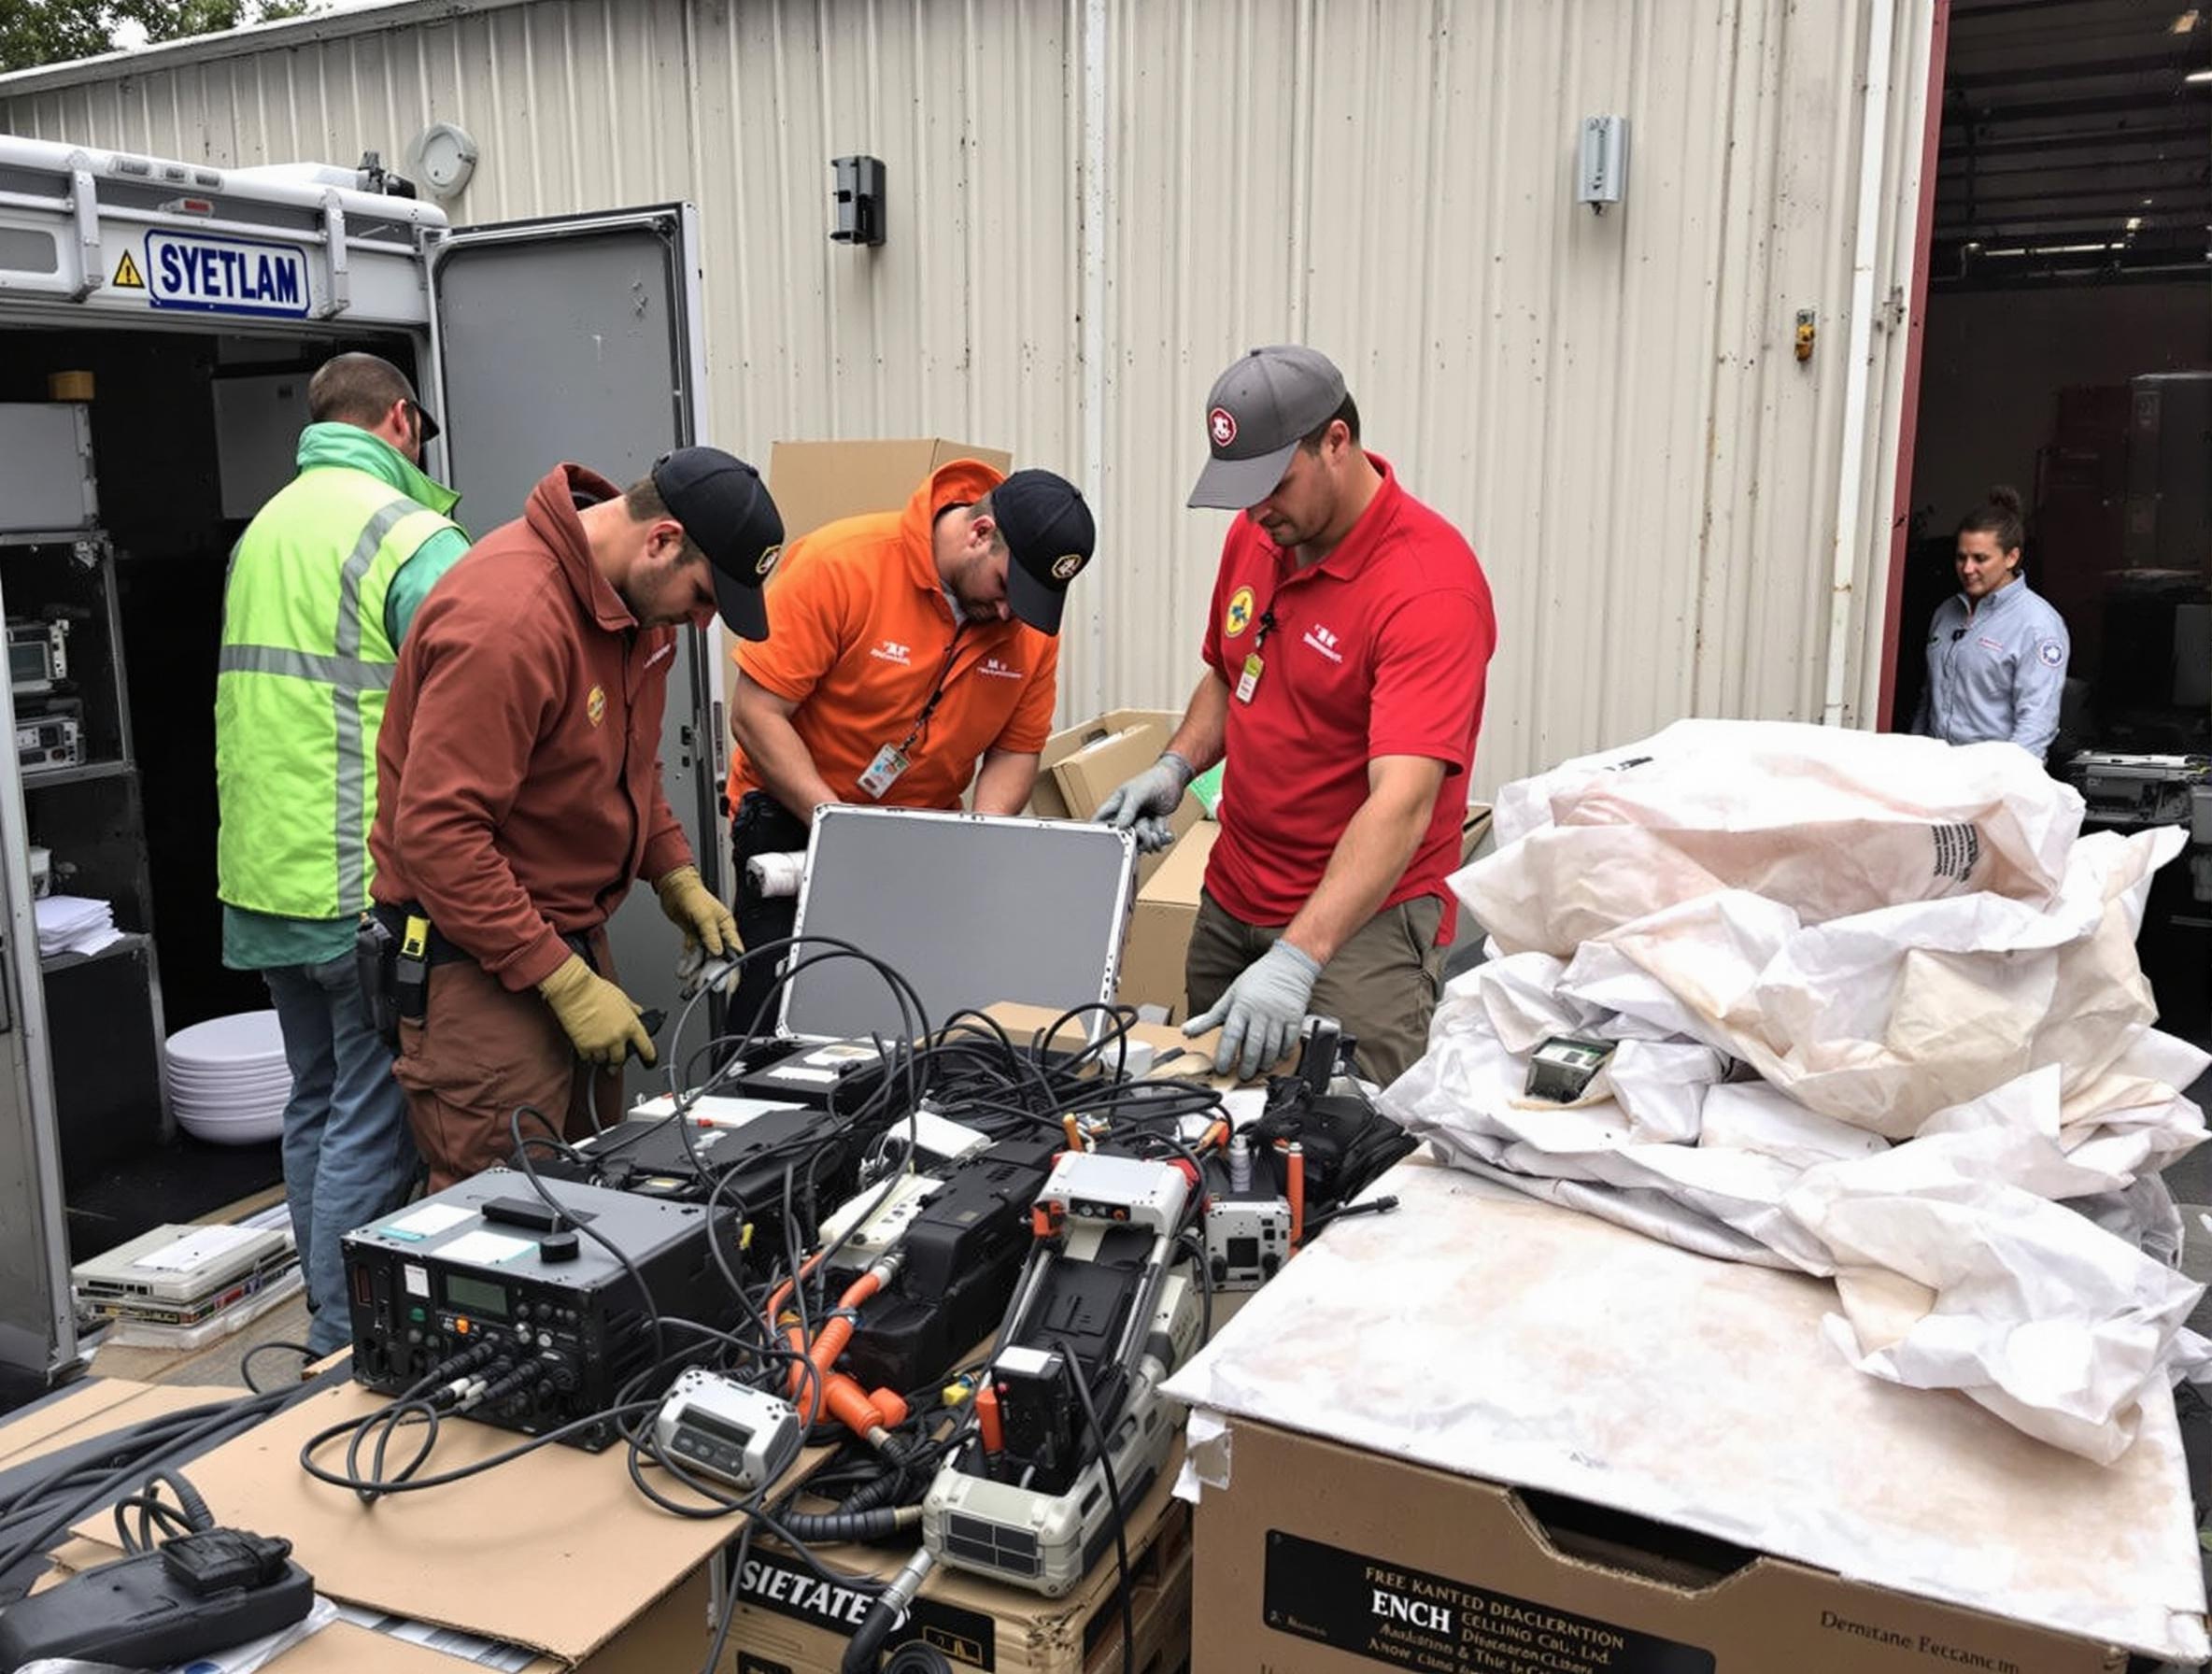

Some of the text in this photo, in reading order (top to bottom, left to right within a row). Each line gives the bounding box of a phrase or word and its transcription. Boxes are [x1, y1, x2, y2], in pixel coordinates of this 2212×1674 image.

[161, 243, 299, 304] SYETLAM
[1366, 1567, 1406, 1589] FREE
[1412, 1579, 1484, 1610] KANTED
[1371, 1589, 1452, 1633] ENCH
